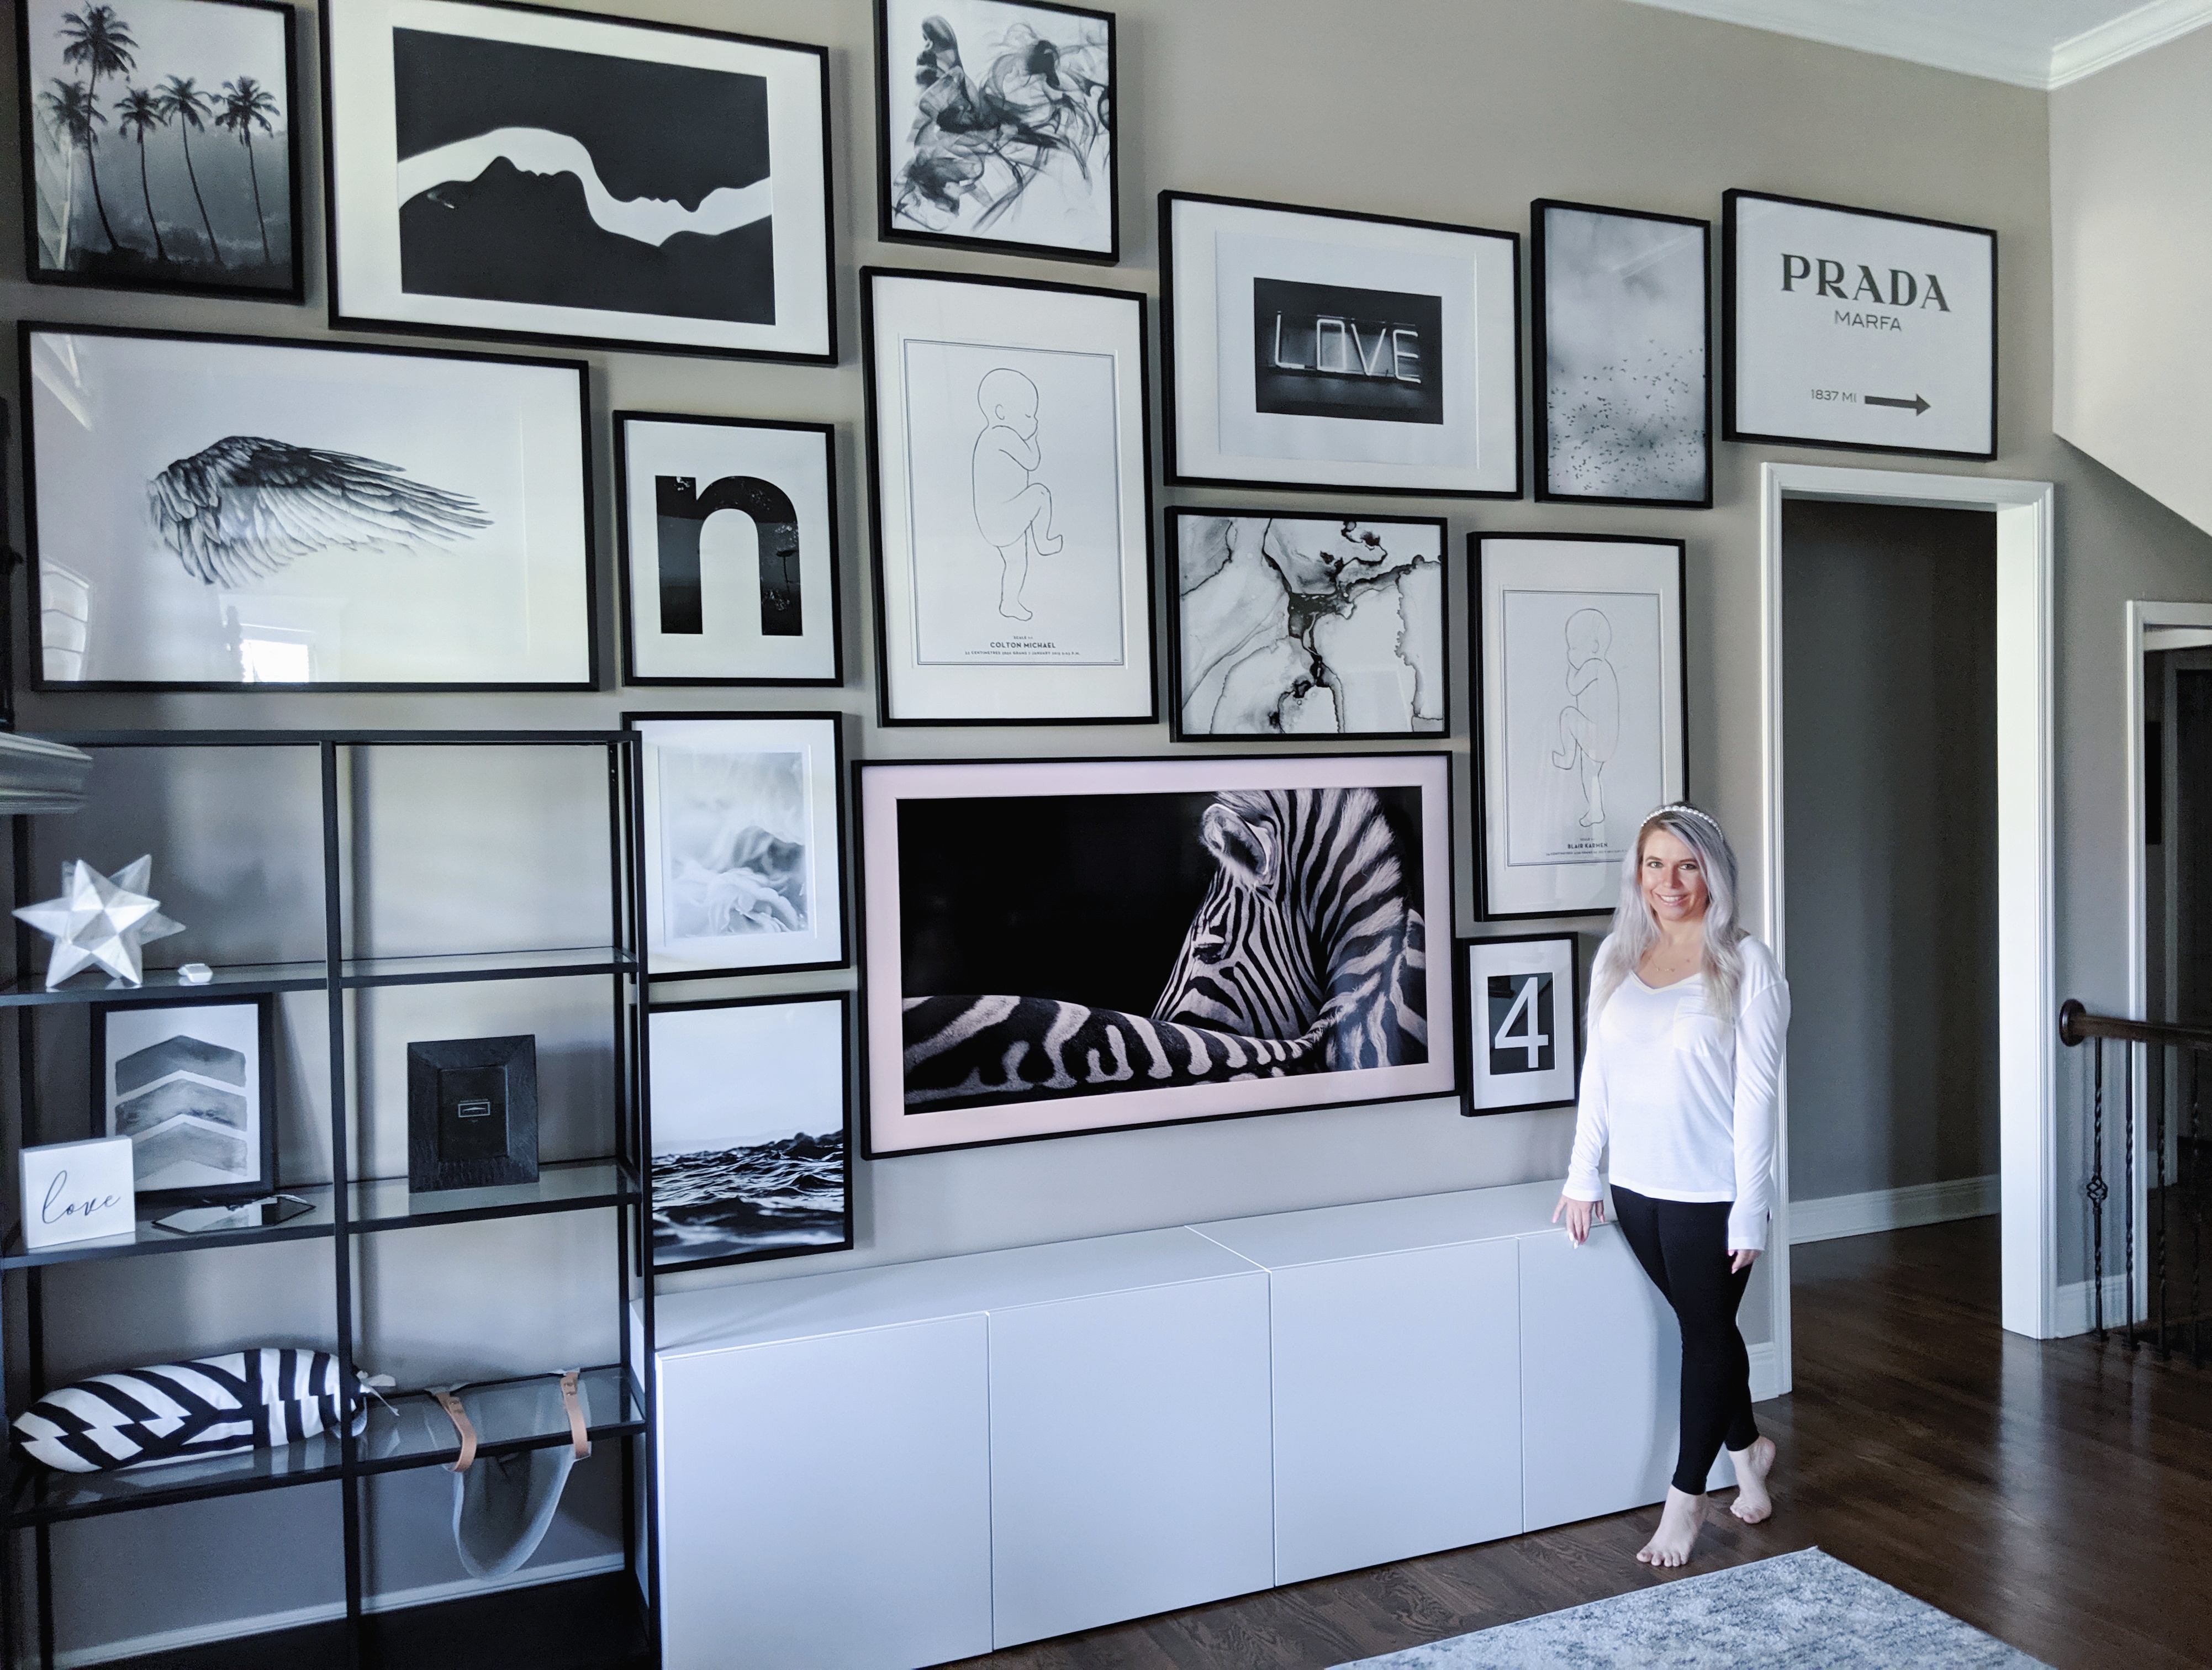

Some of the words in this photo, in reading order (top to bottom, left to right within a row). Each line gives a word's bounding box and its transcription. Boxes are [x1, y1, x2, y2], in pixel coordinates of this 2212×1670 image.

[1781, 253, 1951, 312] PRADA
[1275, 311, 1421, 384] LOVE
[1834, 310, 1902, 331] MARFA
[1811, 389, 1839, 401] 1837
[1842, 392, 1857, 403] MI
[655, 475, 804, 636] n
[1495, 977, 1549, 1069] 4
[42, 1170, 122, 1224] love
